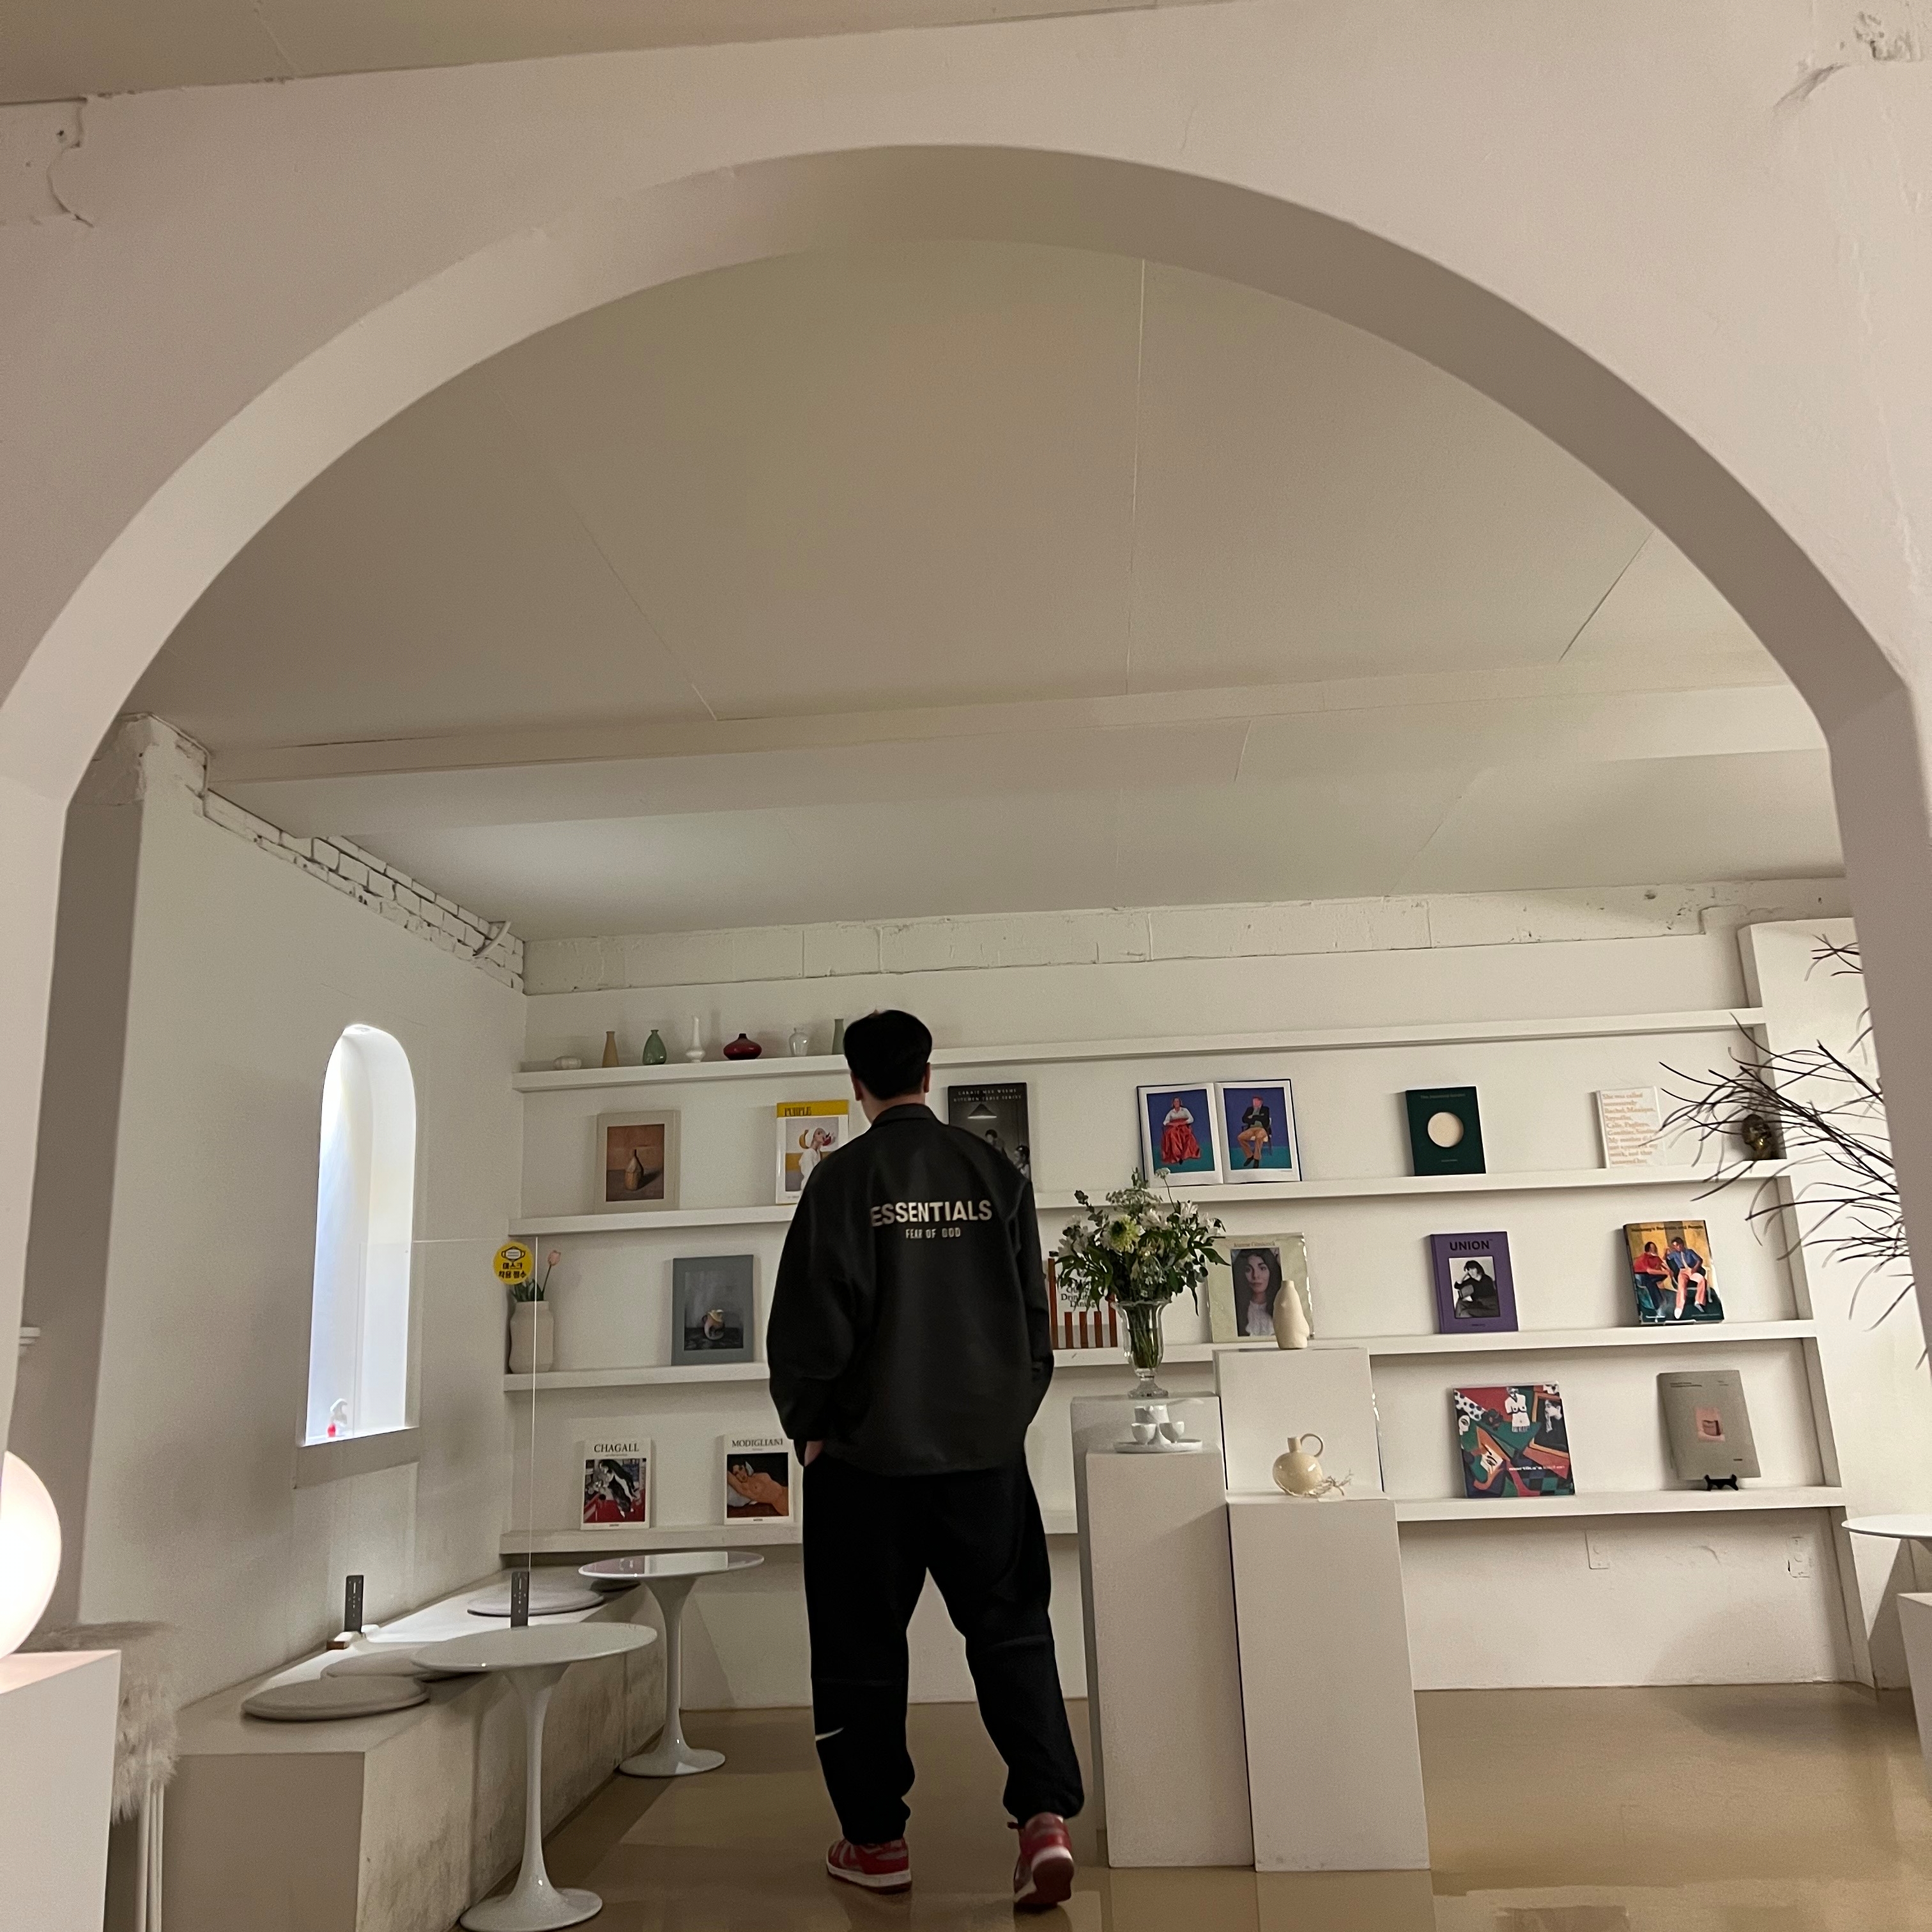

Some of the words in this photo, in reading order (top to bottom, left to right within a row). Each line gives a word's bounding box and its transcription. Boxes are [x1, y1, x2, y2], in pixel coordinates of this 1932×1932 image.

[870, 1200, 992, 1227] ESSENTIALS
[905, 1229, 923, 1239] FEAR
[926, 1229, 936, 1238] OF
[942, 1227, 961, 1238] GOD
[1450, 1240, 1490, 1251] UNION
[594, 1443, 640, 1453] CHAGALL
[732, 1438, 783, 1447] MODIGLIANI
